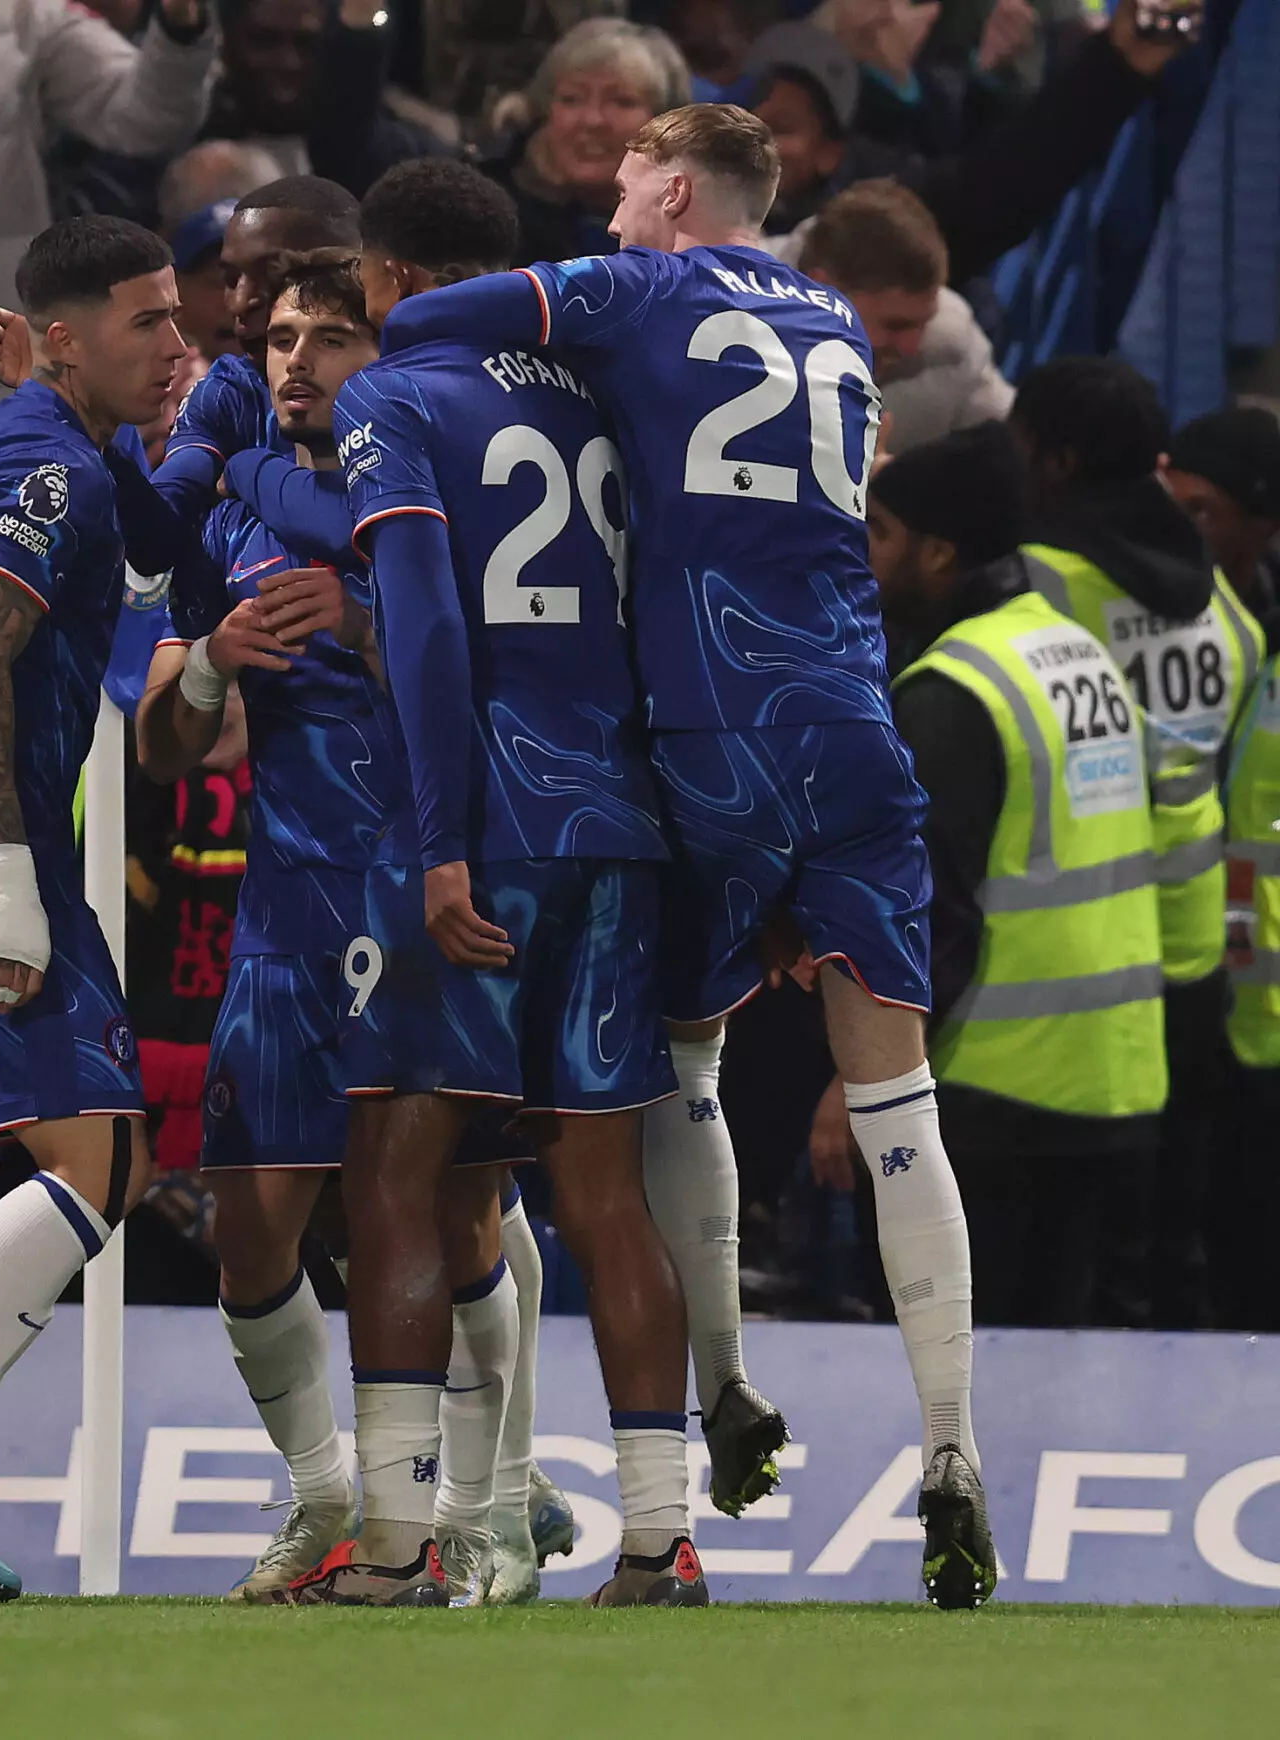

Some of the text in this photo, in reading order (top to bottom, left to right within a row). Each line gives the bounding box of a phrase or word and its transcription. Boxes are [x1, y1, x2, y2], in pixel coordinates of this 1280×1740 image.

[711, 267, 853, 328] PALMER
[337, 421, 373, 467] ever
[683, 310, 882, 522] 20
[18, 522, 49, 547] room
[481, 424, 629, 630] 29
[1050, 670, 1130, 744] 226
[1123, 640, 1225, 713] 108
[344, 935, 383, 1017] 9
